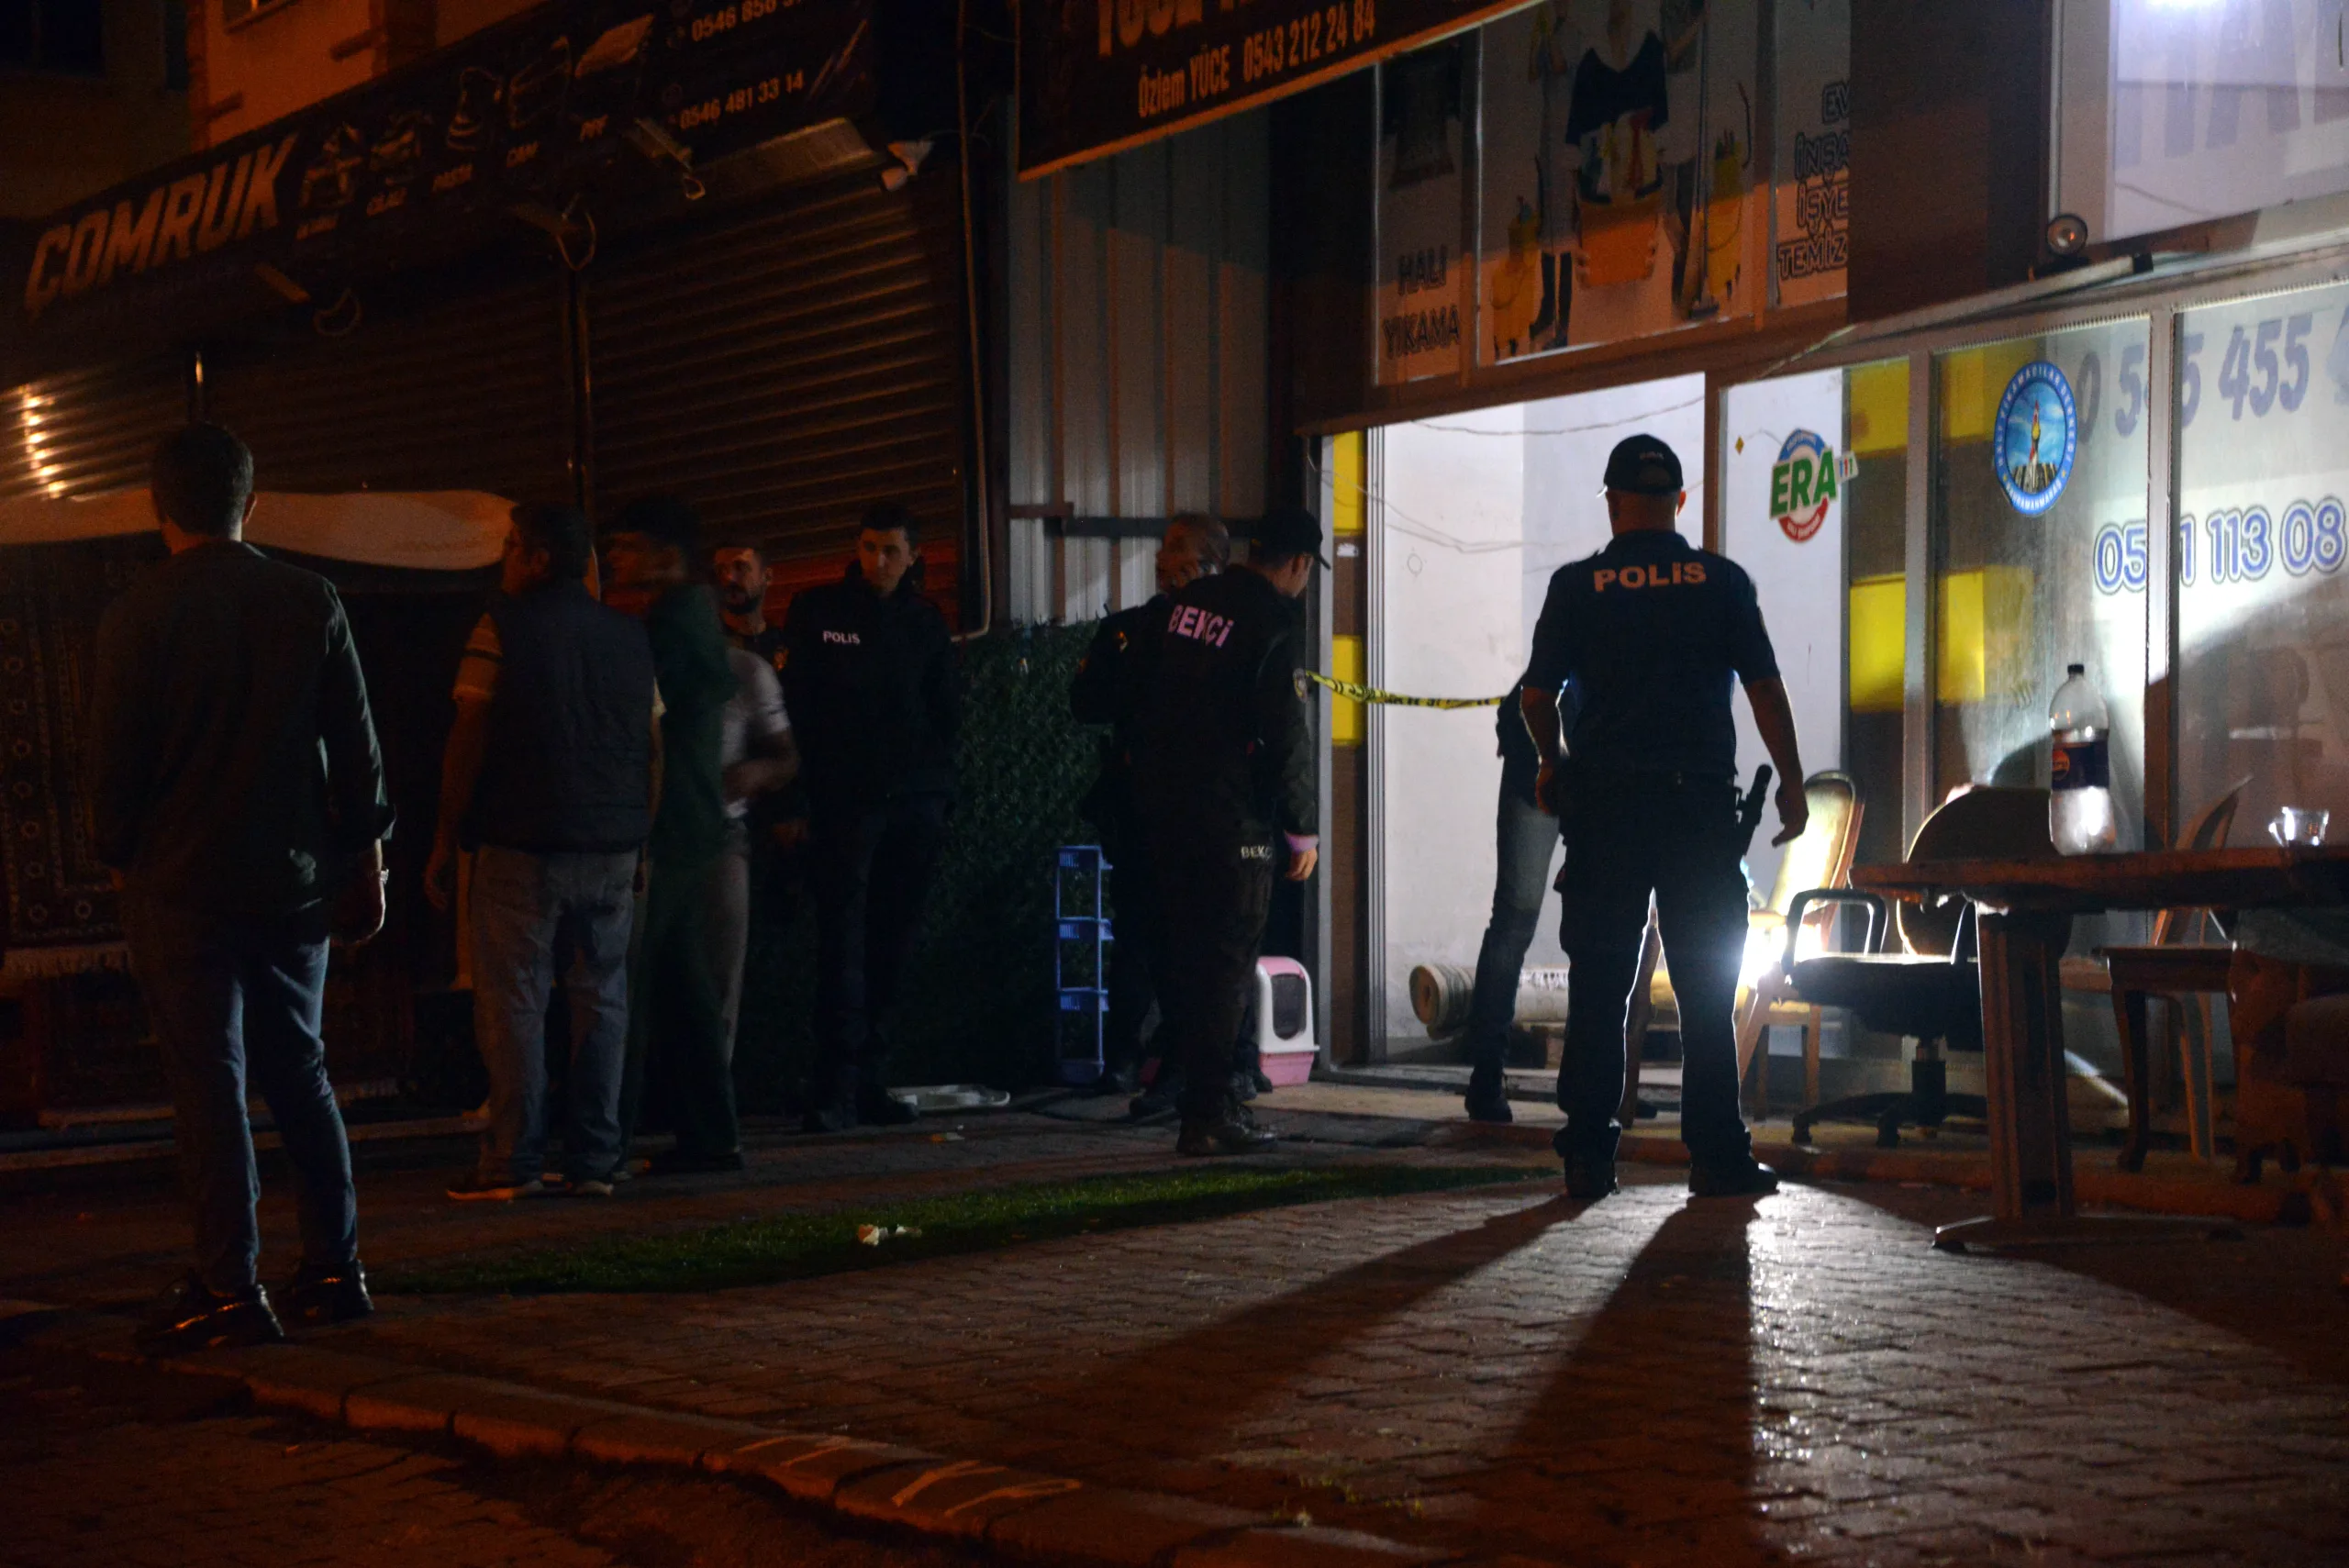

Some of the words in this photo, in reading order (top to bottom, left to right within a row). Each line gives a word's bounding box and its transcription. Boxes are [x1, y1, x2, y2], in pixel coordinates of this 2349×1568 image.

[725, 87, 752, 113] 481
[757, 77, 780, 103] 33
[785, 69, 804, 94] 14
[1138, 64, 1186, 117] Özlem
[1190, 42, 1230, 102] YÜCE
[1242, 25, 1285, 83] 0543
[1287, 11, 1321, 67] 212
[1325, 3, 1348, 53] 24
[1383, 305, 1461, 360] YIKAMA
[2219, 312, 2312, 422] 455
[1771, 447, 1837, 516] ERA
[2095, 515, 2196, 595] 051
[2206, 506, 2273, 582] 113
[2281, 497, 2347, 576] 08
